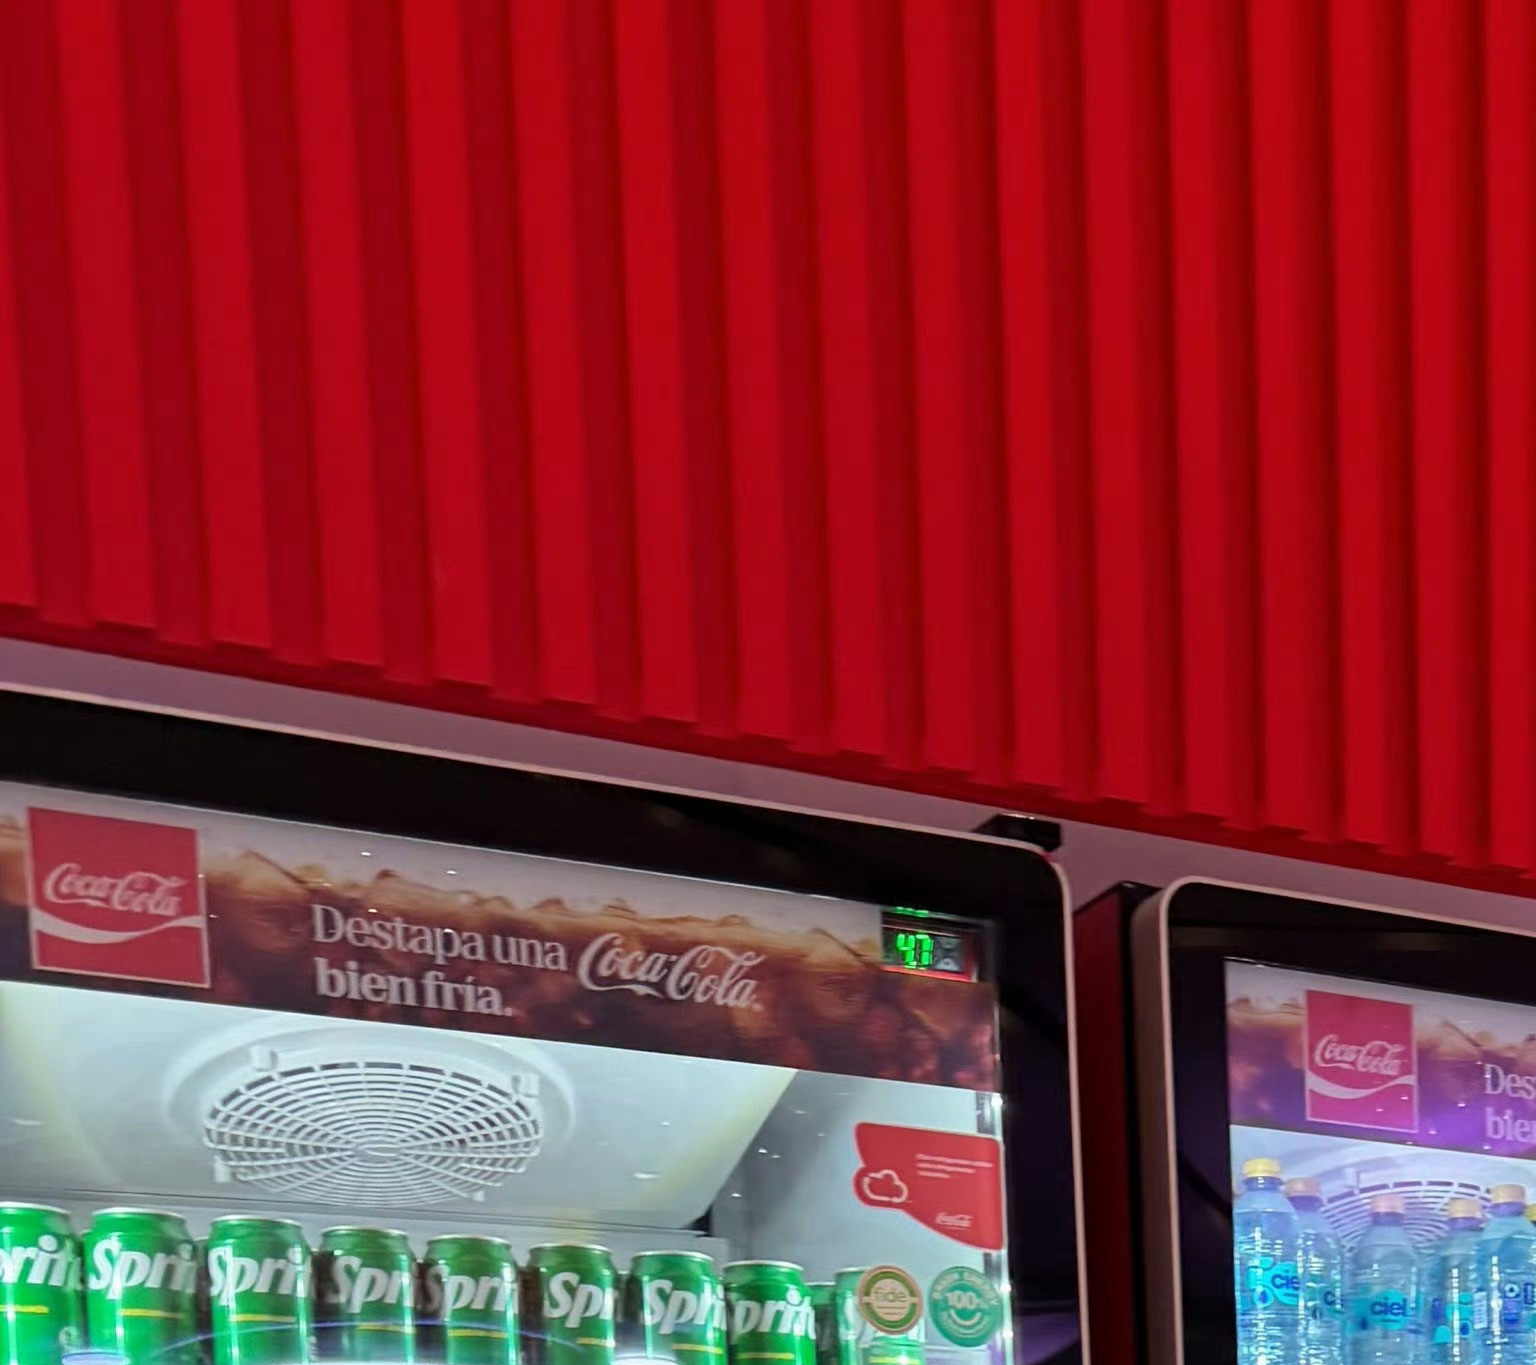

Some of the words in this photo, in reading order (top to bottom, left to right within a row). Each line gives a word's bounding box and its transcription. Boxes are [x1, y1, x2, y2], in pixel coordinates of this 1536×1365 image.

[44, 862, 184, 917] Coca-Cola
[311, 904, 484, 965] Destapa
[493, 935, 568, 971] una
[577, 932, 765, 1011] Coca-Cola
[315, 957, 417, 1006] bien
[421, 977, 514, 1017] fría.
[1315, 1034, 1406, 1076] Coca-Cola
